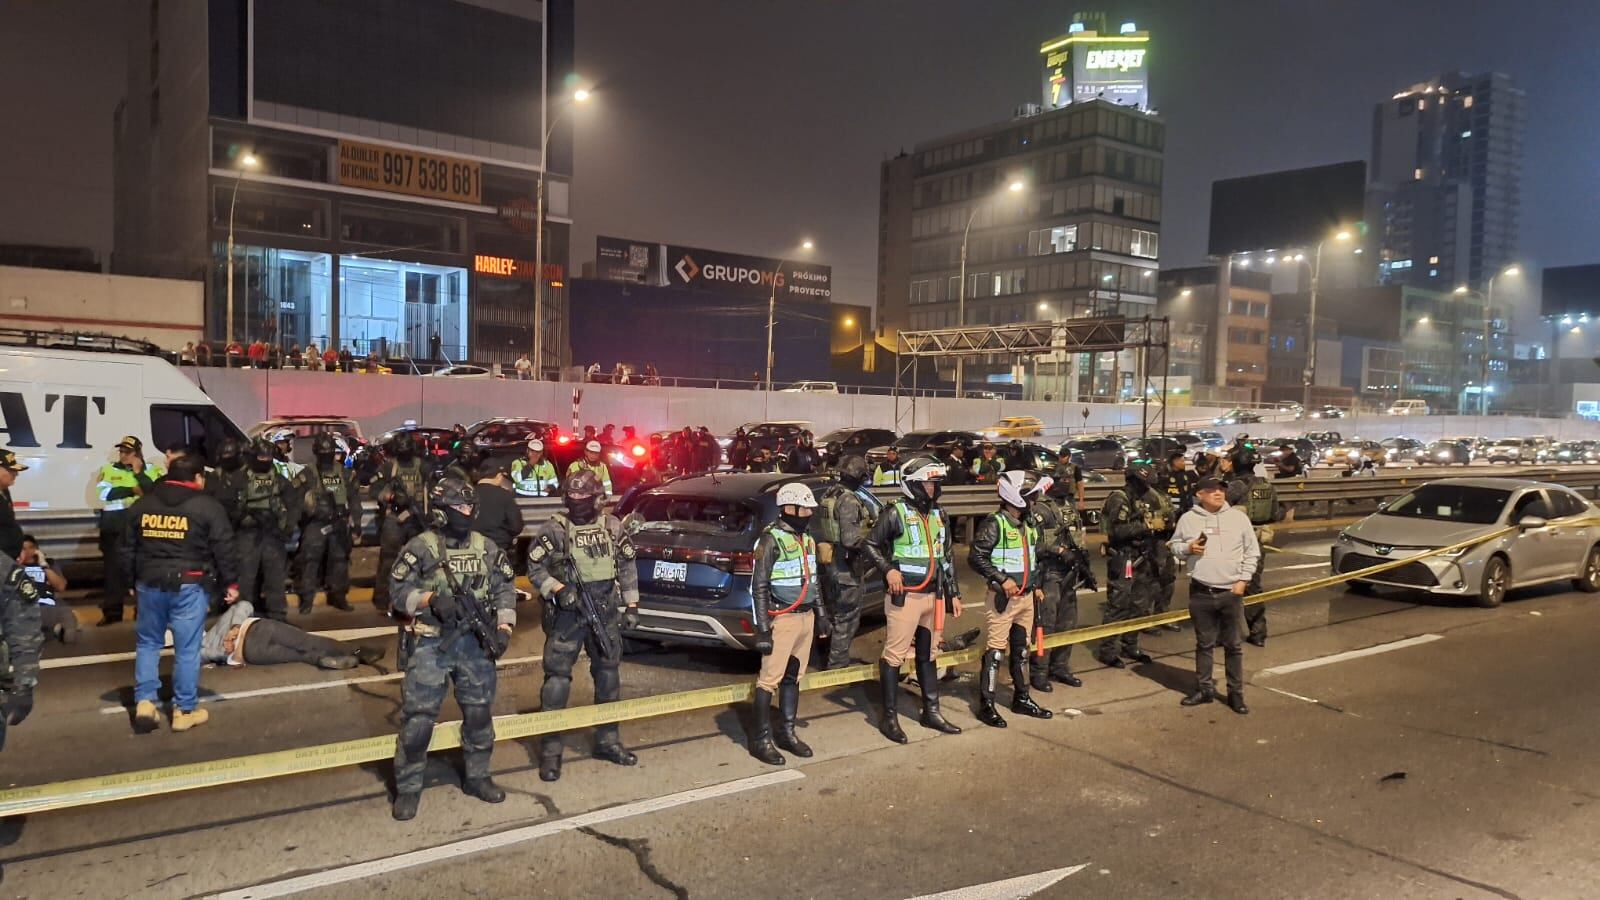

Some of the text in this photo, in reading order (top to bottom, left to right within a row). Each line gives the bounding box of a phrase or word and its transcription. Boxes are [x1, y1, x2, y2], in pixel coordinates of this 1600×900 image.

[341, 145, 379, 161] ALQUILER
[341, 163, 379, 182] OFICINAS
[383, 152, 479, 197] 997 538 681
[792, 270, 828, 283] PRÓXIMO
[789, 285, 831, 297] PROYECTO
[141, 513, 188, 531] POLICIA
[577, 533, 604, 547] SUAT
[448, 559, 480, 573] SUAT
